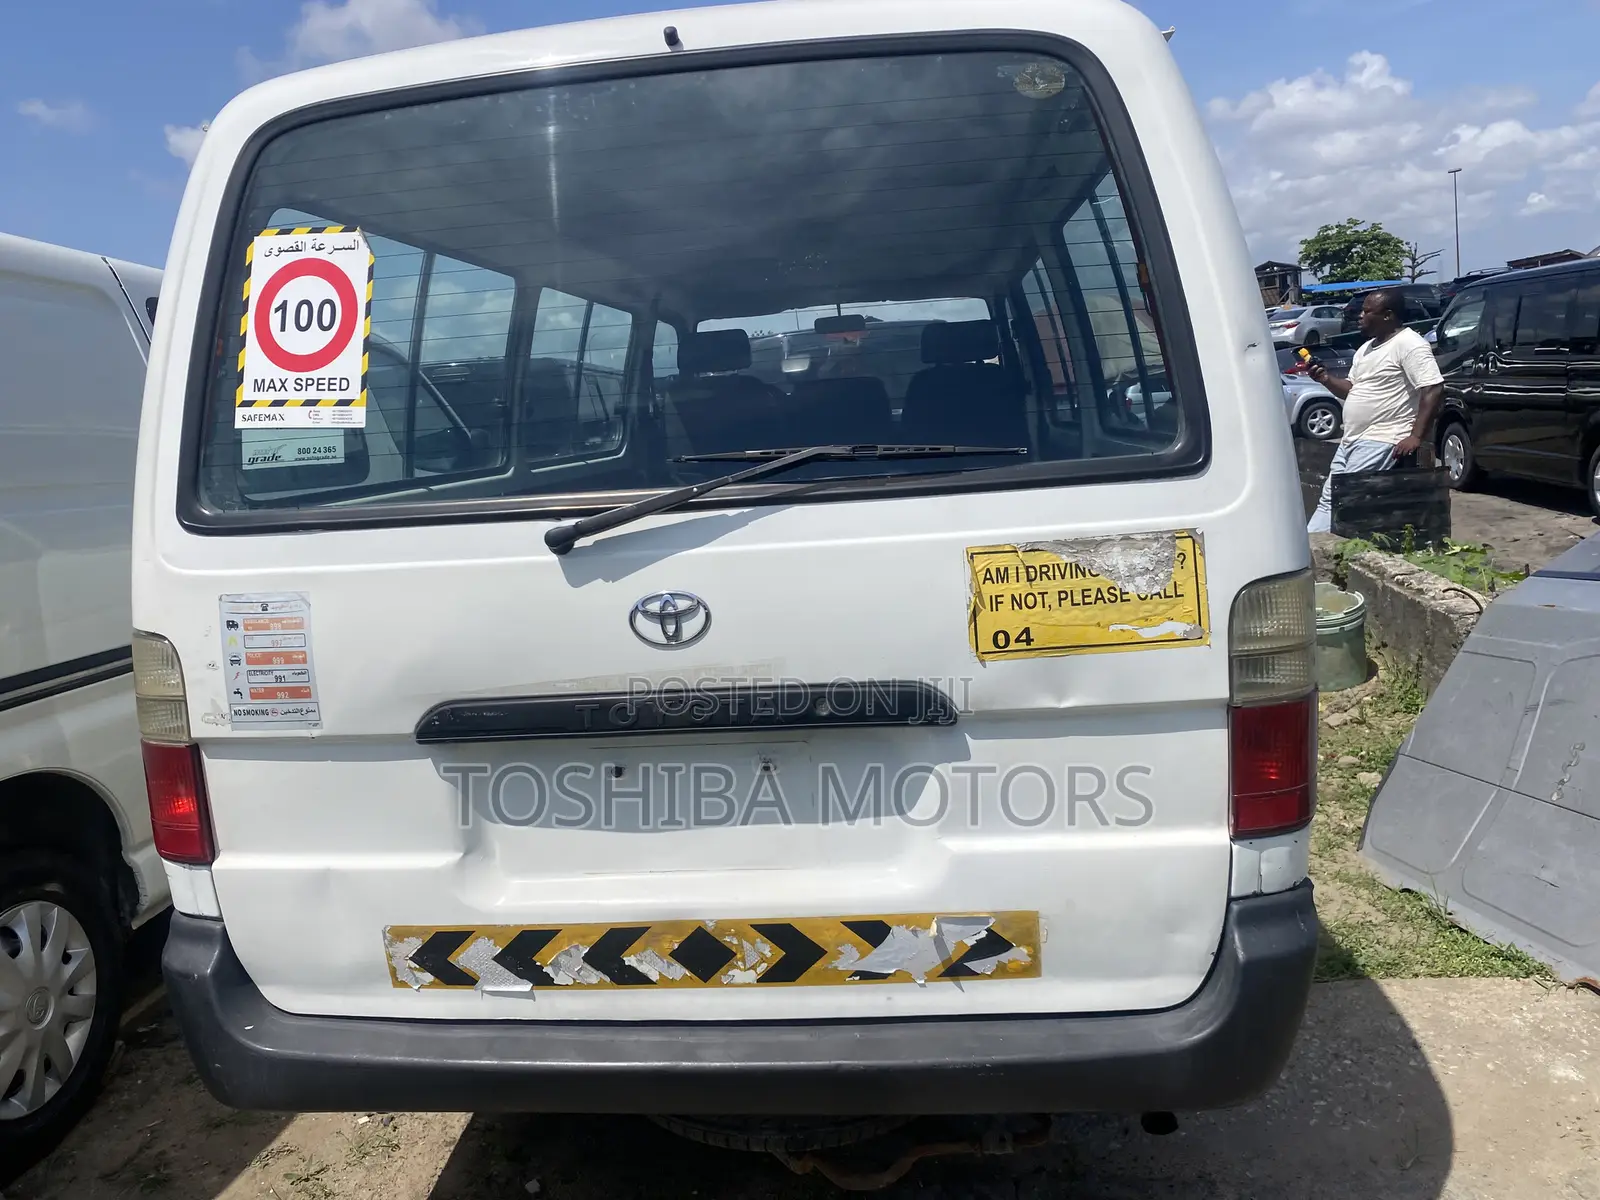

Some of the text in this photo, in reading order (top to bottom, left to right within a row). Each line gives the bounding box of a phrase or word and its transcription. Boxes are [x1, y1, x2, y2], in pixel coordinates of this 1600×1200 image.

[264, 239, 360, 258] السرعة القصوى
[273, 298, 337, 333] 100
[253, 377, 351, 393] MAX SPEED
[241, 413, 285, 423] SAFEMAX
[297, 445, 337, 455] 800 24 365
[246, 453, 282, 465] grade
[982, 567, 1010, 585] AM
[1015, 566, 1020, 583] I
[989, 594, 1005, 612] IF
[1010, 591, 1052, 612] NOT,
[1057, 586, 1131, 608] PLEASE
[992, 626, 1035, 649] 04
[276, 691, 289, 699] 992
[243, 708, 269, 716] SMOKING
